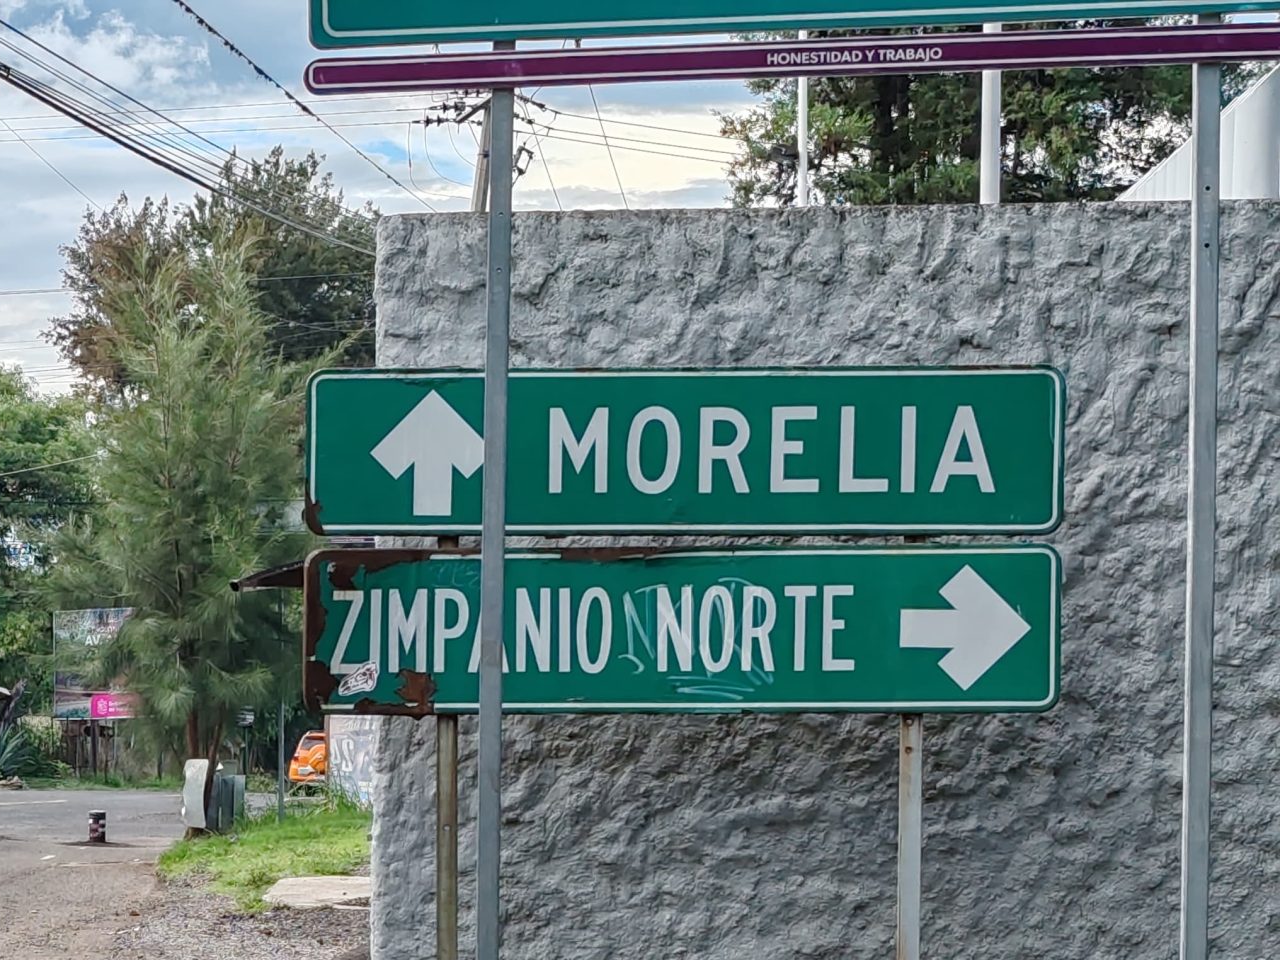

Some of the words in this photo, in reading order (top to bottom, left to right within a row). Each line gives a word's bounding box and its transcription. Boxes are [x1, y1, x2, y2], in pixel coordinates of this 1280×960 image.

[767, 51, 862, 65] HONESTIDAD
[865, 50, 876, 61] Y
[878, 47, 943, 62] TRABAJO
[549, 404, 996, 495] MORELIA
[656, 584, 856, 673] NORTE
